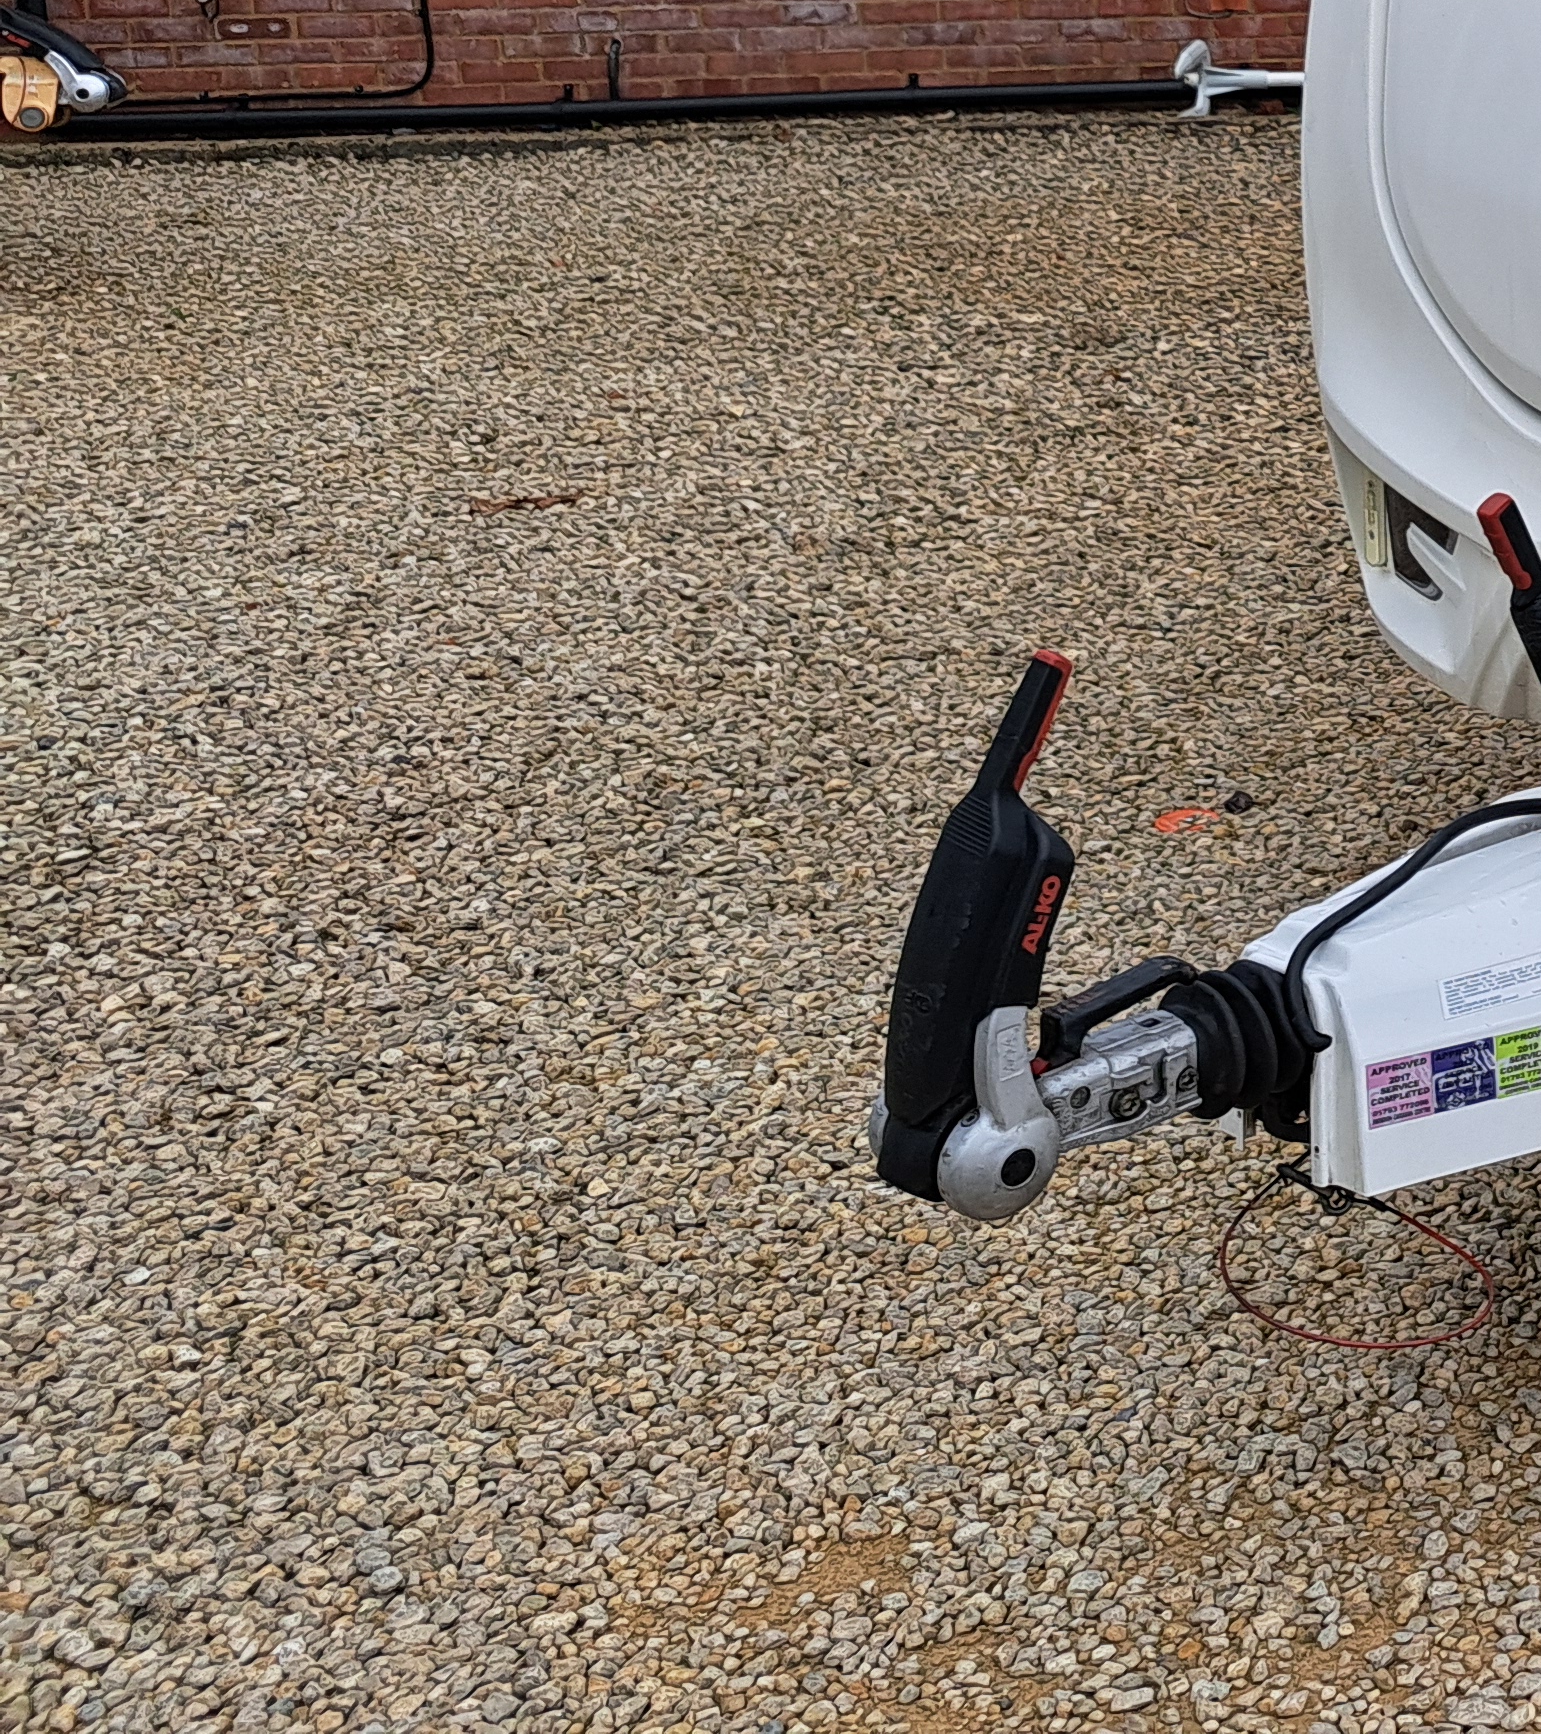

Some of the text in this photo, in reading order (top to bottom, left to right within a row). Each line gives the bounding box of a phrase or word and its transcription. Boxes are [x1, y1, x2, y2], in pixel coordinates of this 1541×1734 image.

[1021, 875, 1061, 955] AL-KO
[1370, 1057, 1427, 1077] APPROVED
[1370, 1086, 1430, 1107] COMPLETED
[1380, 1079, 1420, 1095] SERVICE
